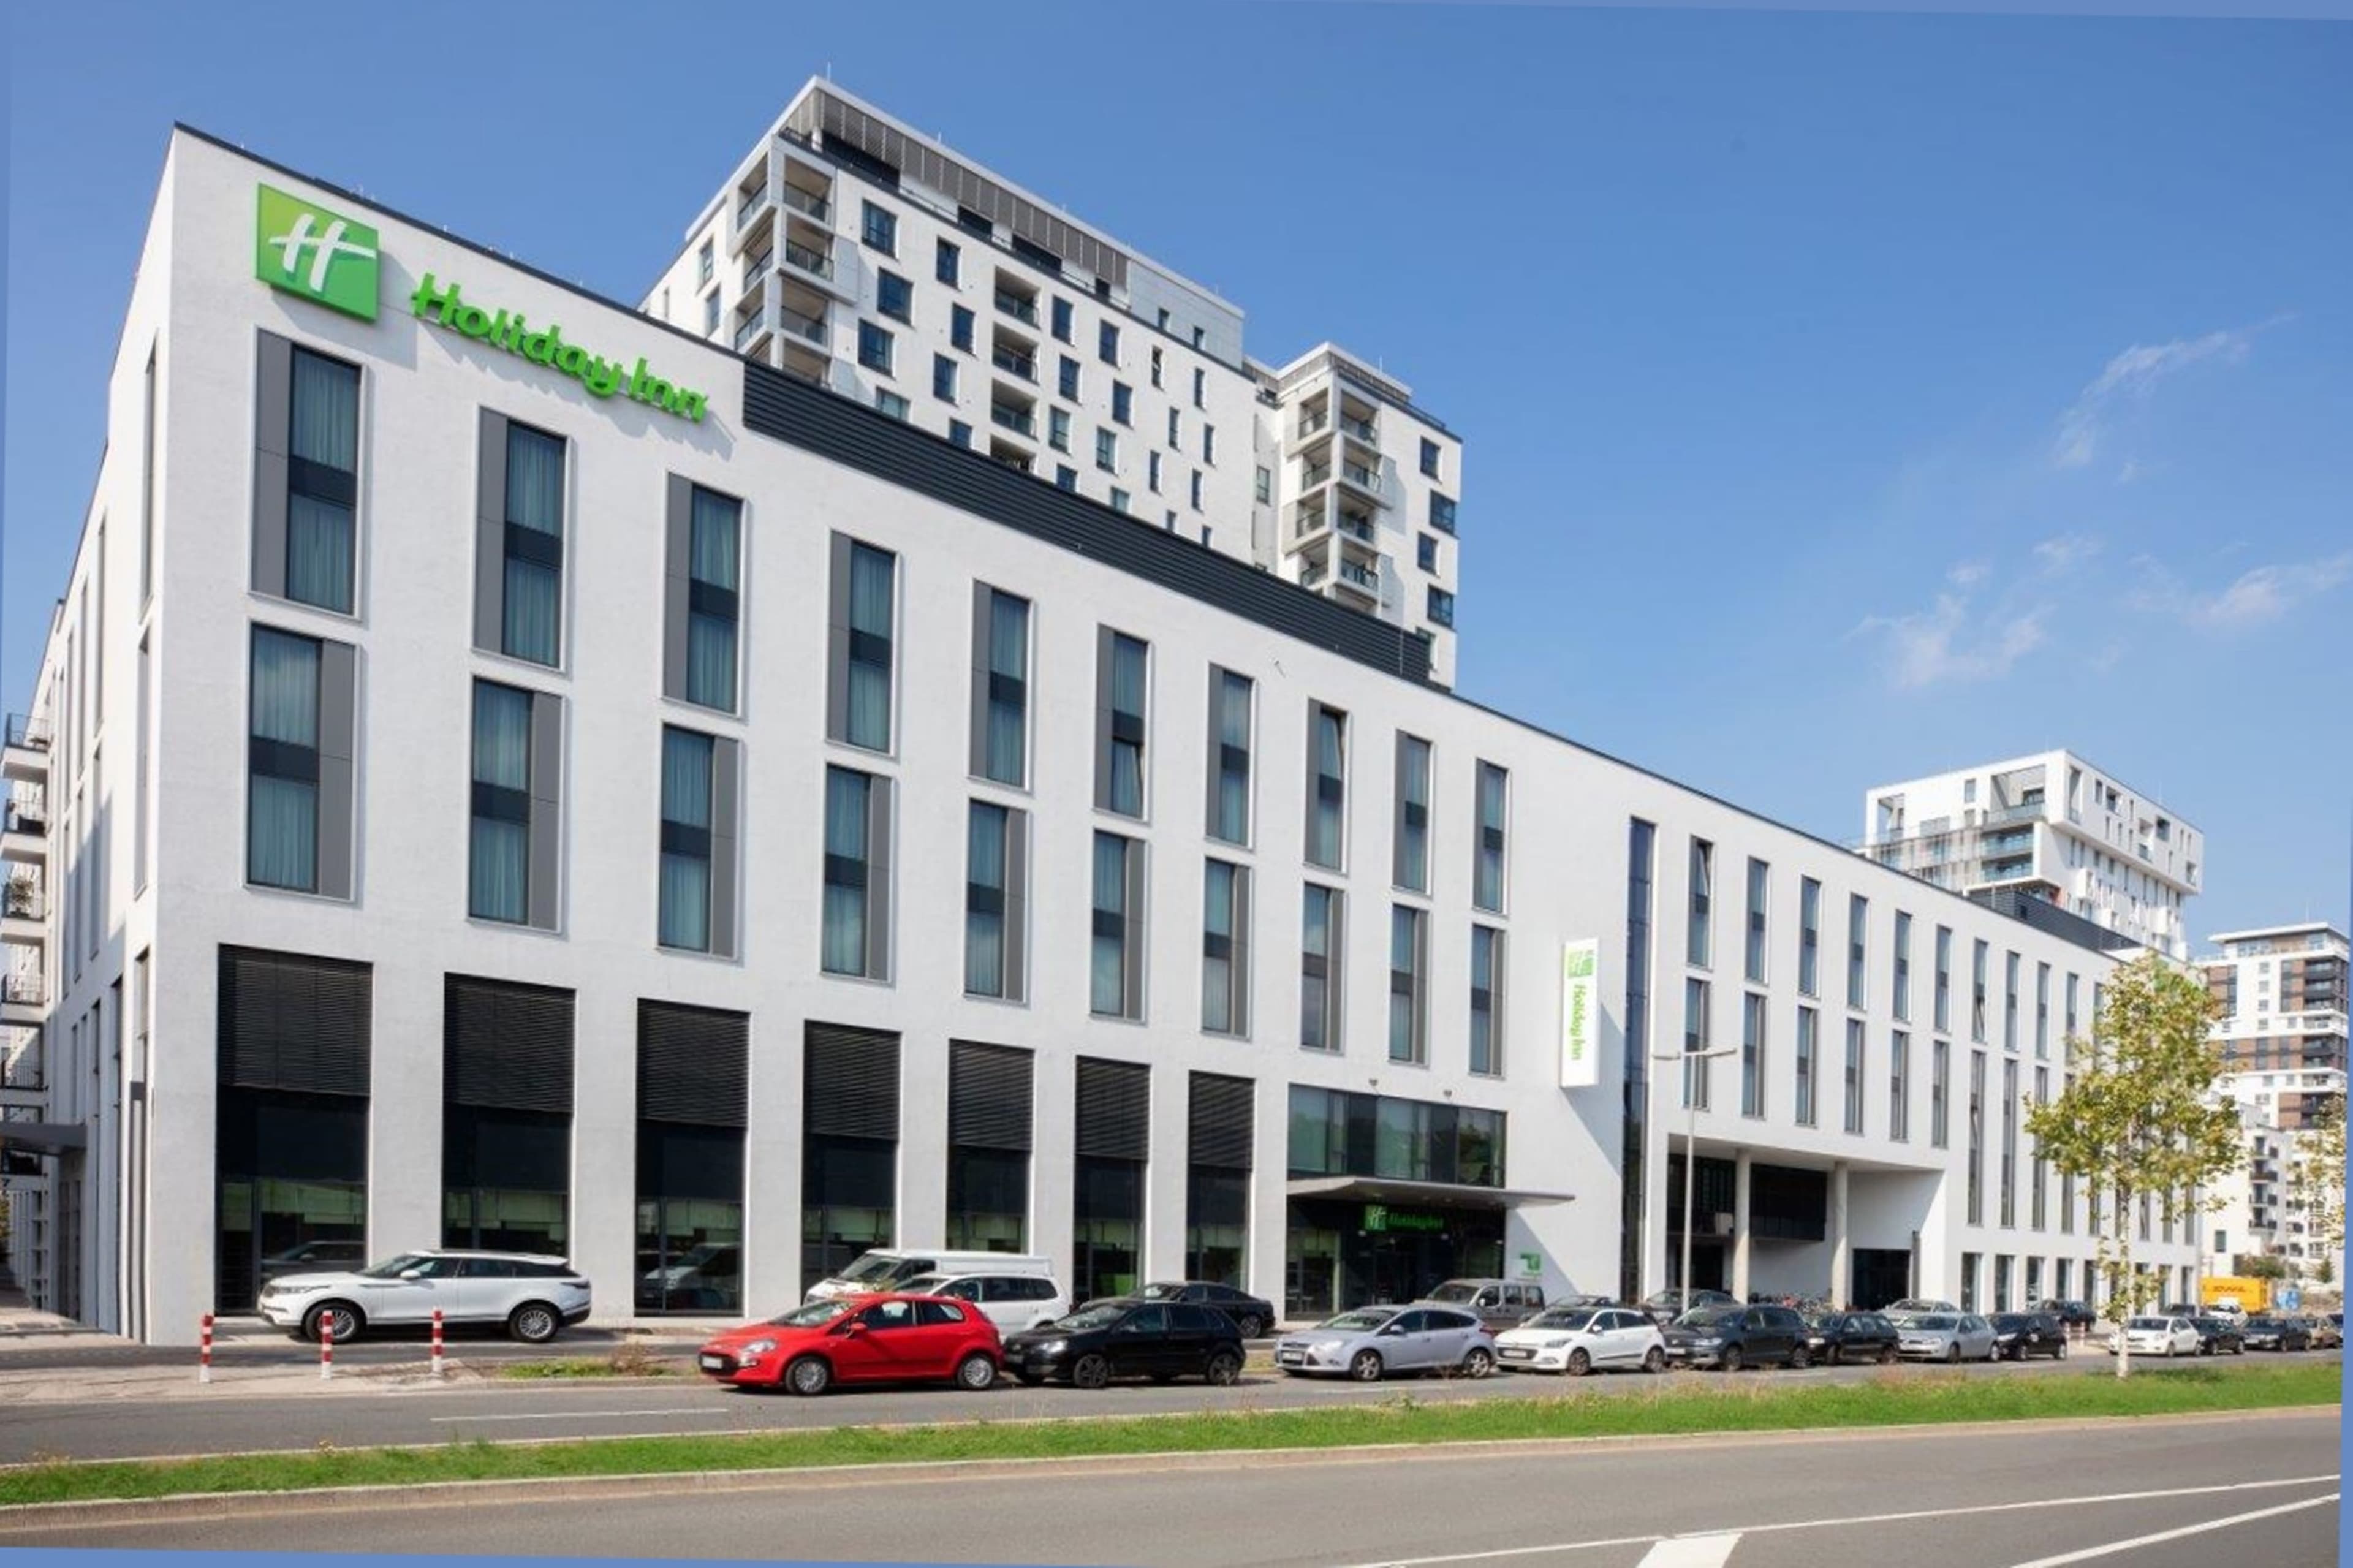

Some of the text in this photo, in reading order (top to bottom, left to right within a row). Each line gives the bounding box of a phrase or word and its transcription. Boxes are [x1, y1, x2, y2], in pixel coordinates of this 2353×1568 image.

[411, 272, 708, 423] Holiday Inn
[1570, 984, 1586, 1060] Holiday Inn
